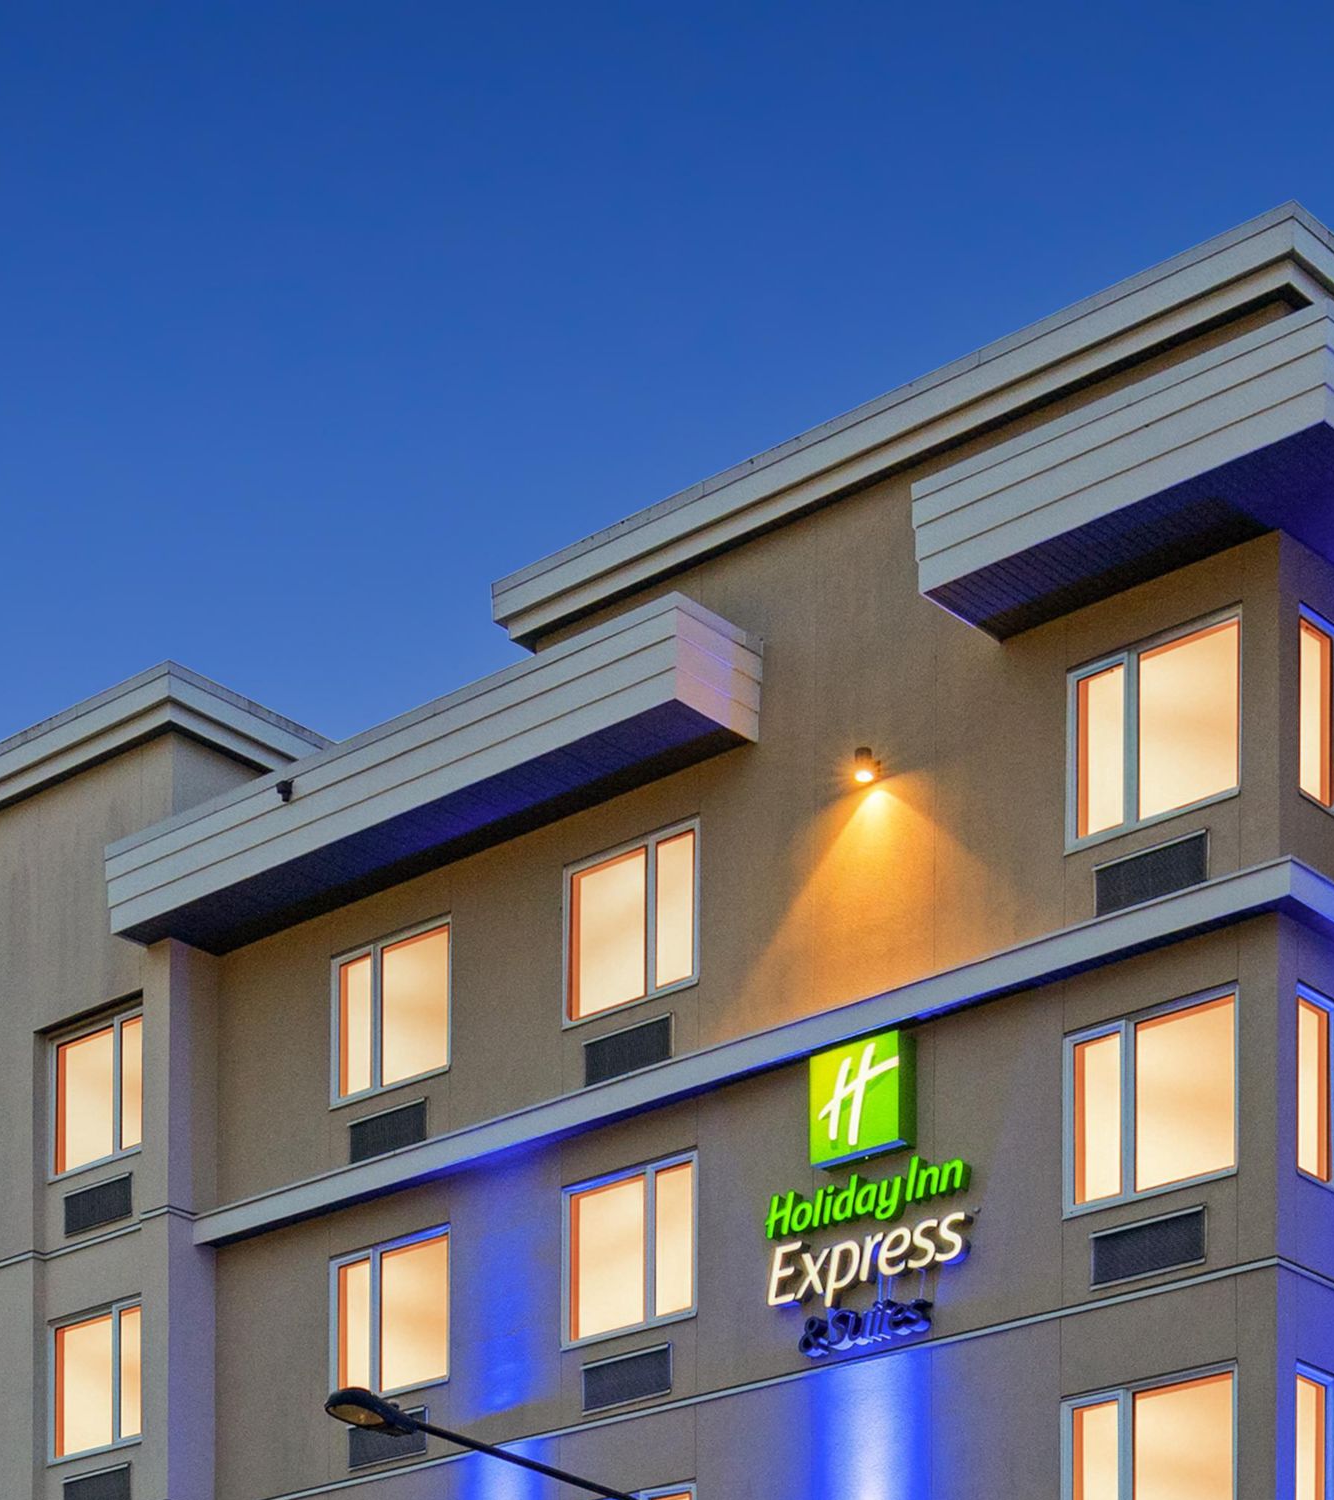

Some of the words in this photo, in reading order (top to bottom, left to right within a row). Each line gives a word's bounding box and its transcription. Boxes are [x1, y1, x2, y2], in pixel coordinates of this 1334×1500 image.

[764, 1173, 903, 1240] Holiday
[905, 1155, 967, 1202] Inn
[767, 1210, 967, 1308] Express
